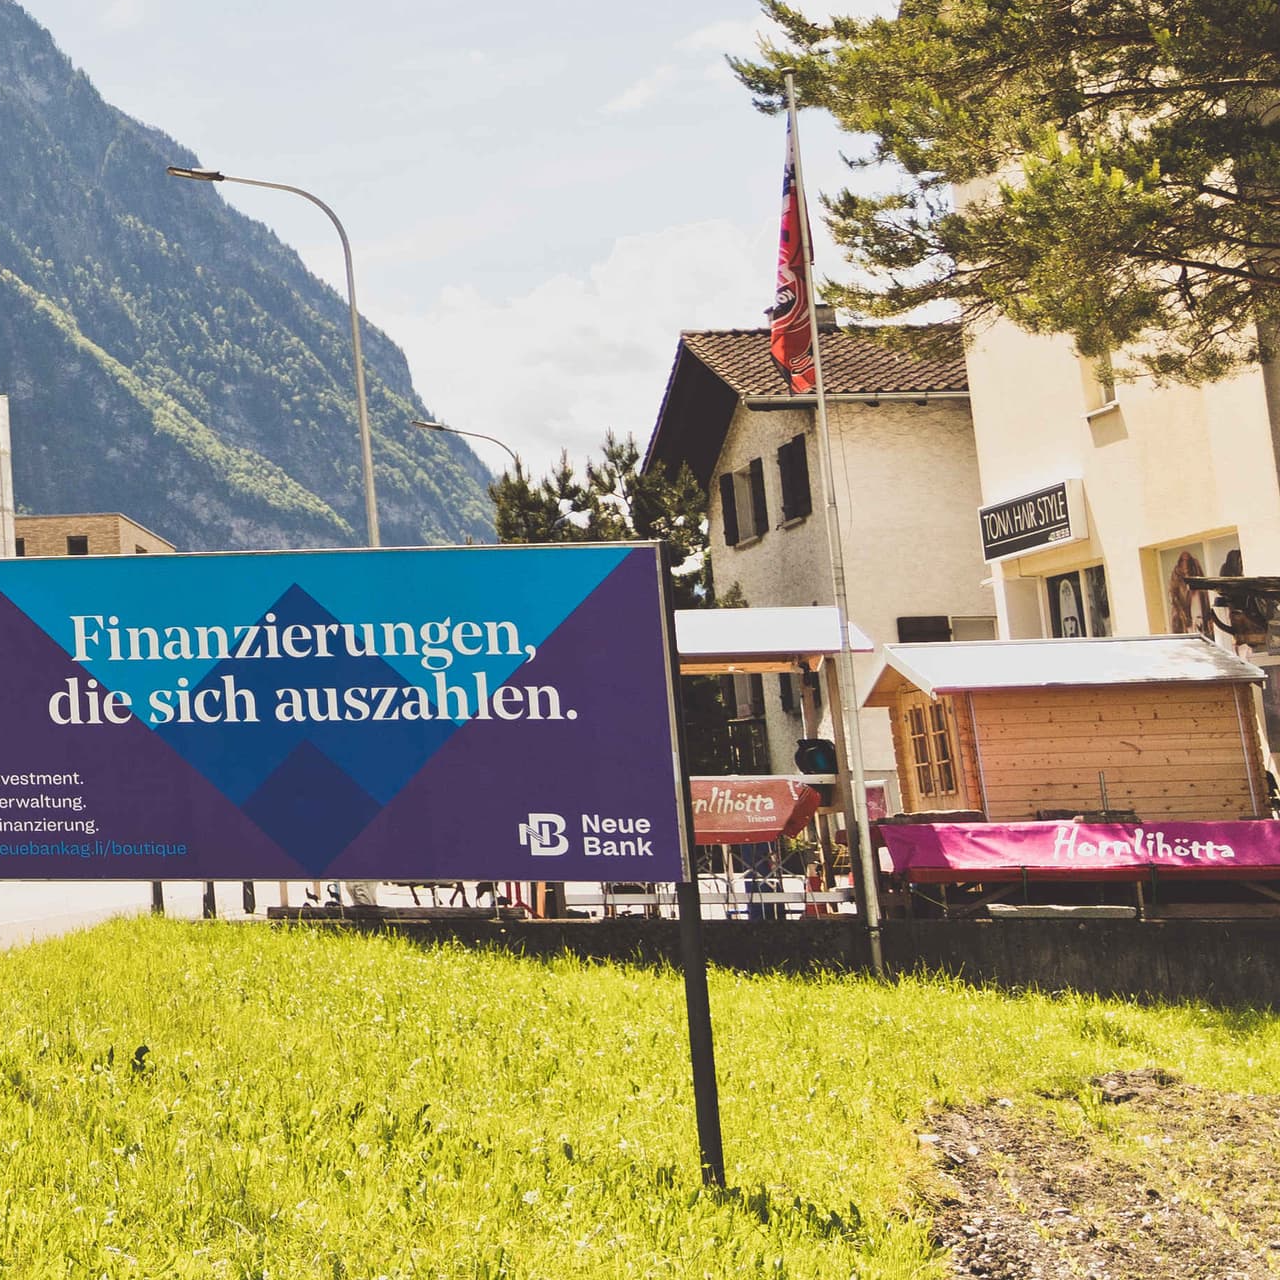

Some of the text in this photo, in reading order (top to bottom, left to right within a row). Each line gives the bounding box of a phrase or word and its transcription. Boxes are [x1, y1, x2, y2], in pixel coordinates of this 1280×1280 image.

[1012, 501, 1038, 532] HAIR
[1037, 491, 1067, 526] STYLE
[70, 612, 537, 670] Finanzierungen,
[48, 671, 578, 725] die sich auszahlen.
[581, 814, 651, 834] Neue
[583, 836, 654, 856] Bank
